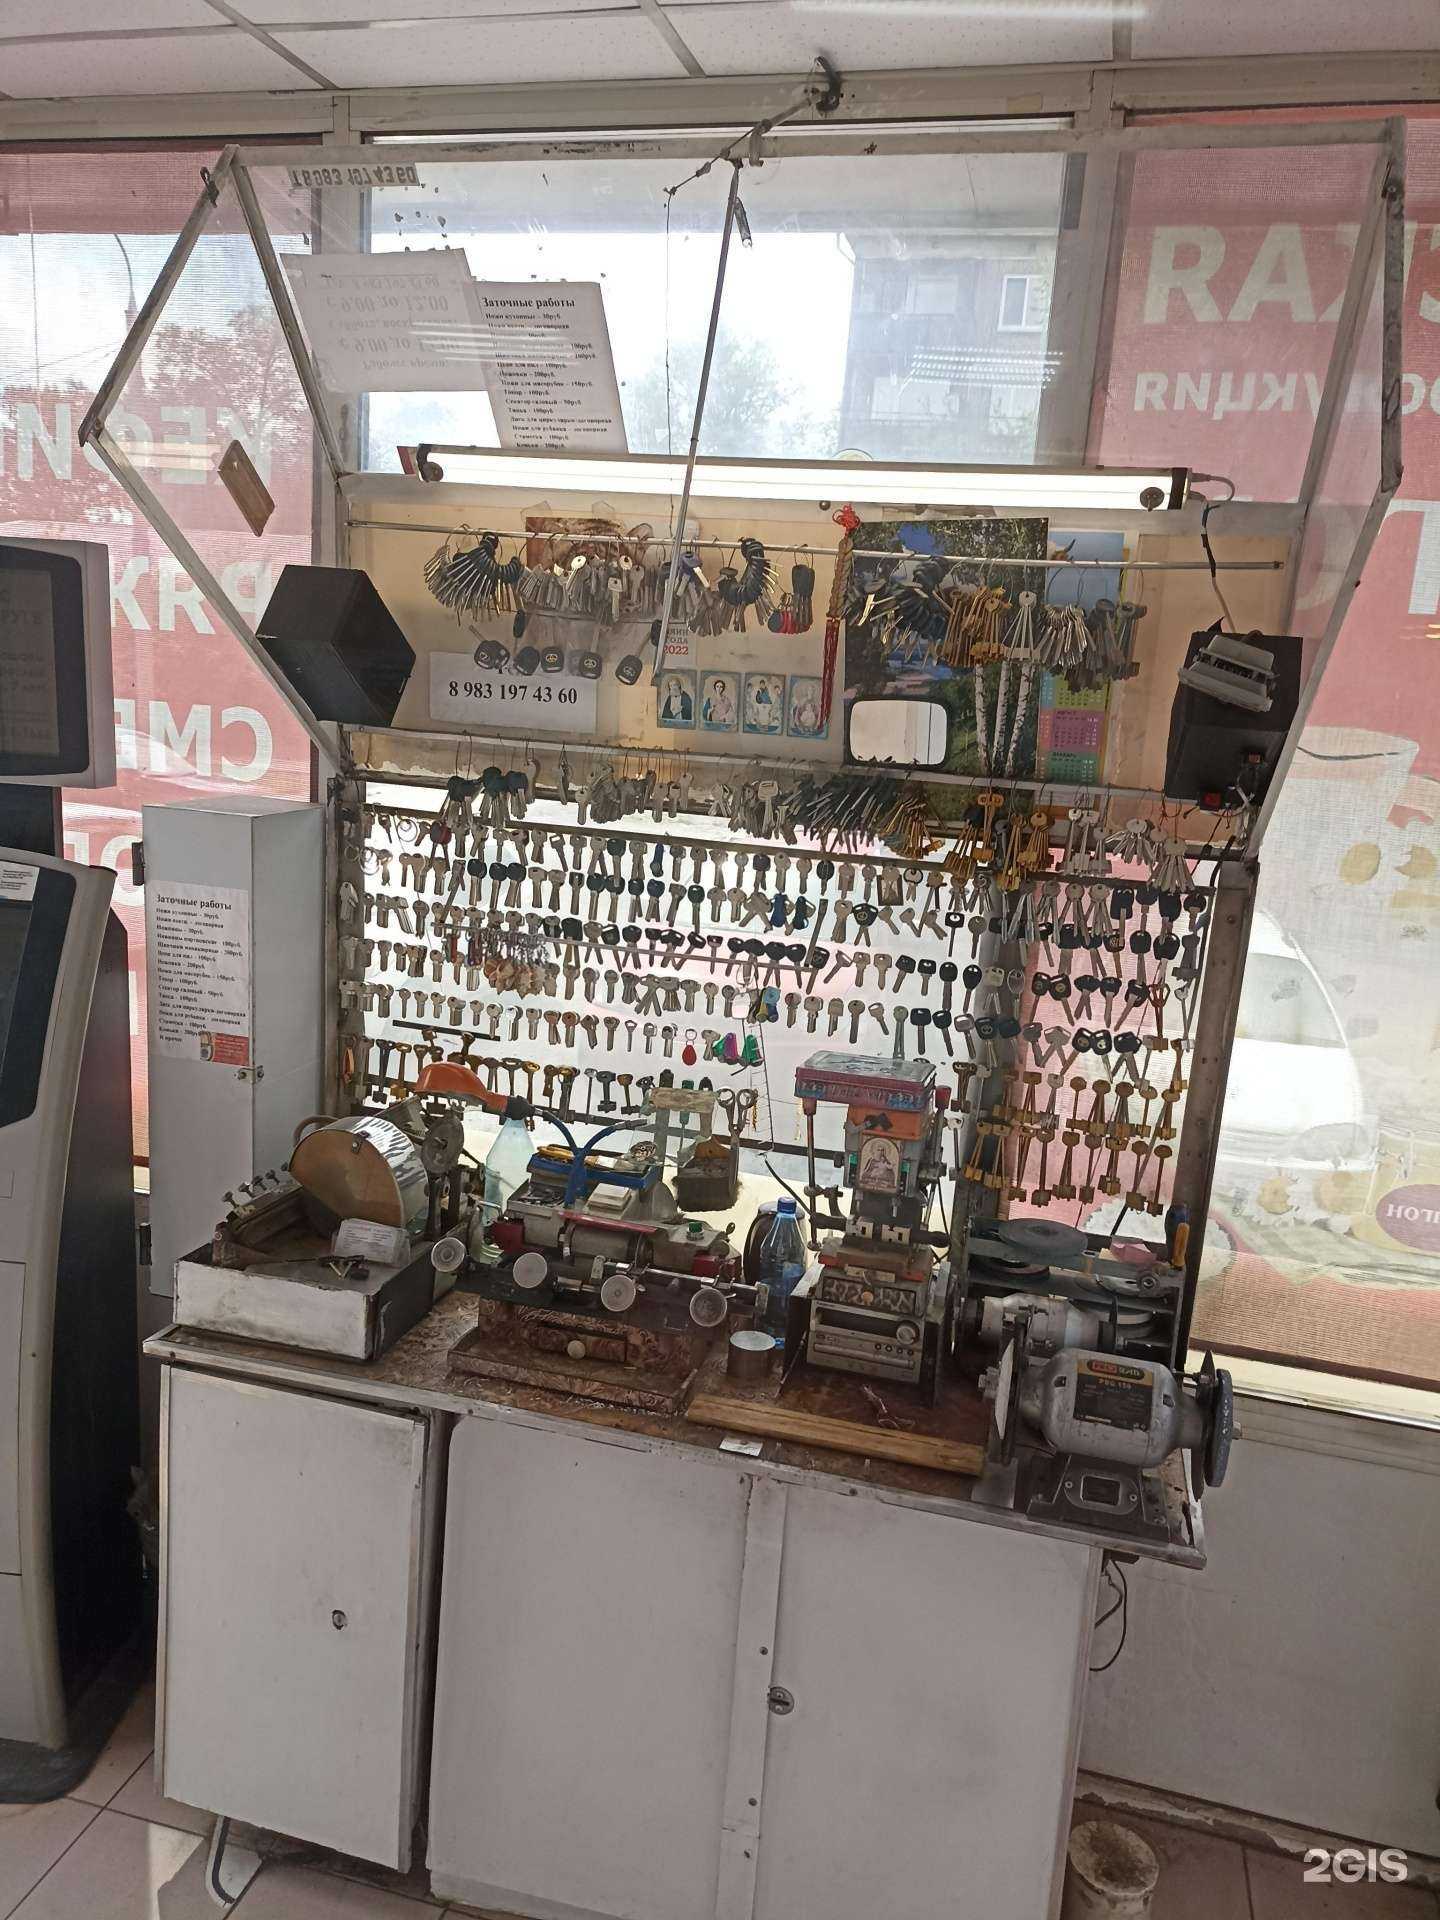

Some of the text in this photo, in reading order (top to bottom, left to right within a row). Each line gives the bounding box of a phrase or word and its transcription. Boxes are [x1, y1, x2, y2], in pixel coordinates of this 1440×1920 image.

[482, 297, 575, 309] Заточные работы
[449, 680, 578, 704] 8 983 197 43 60
[157, 894, 232, 911] Заточные работы
